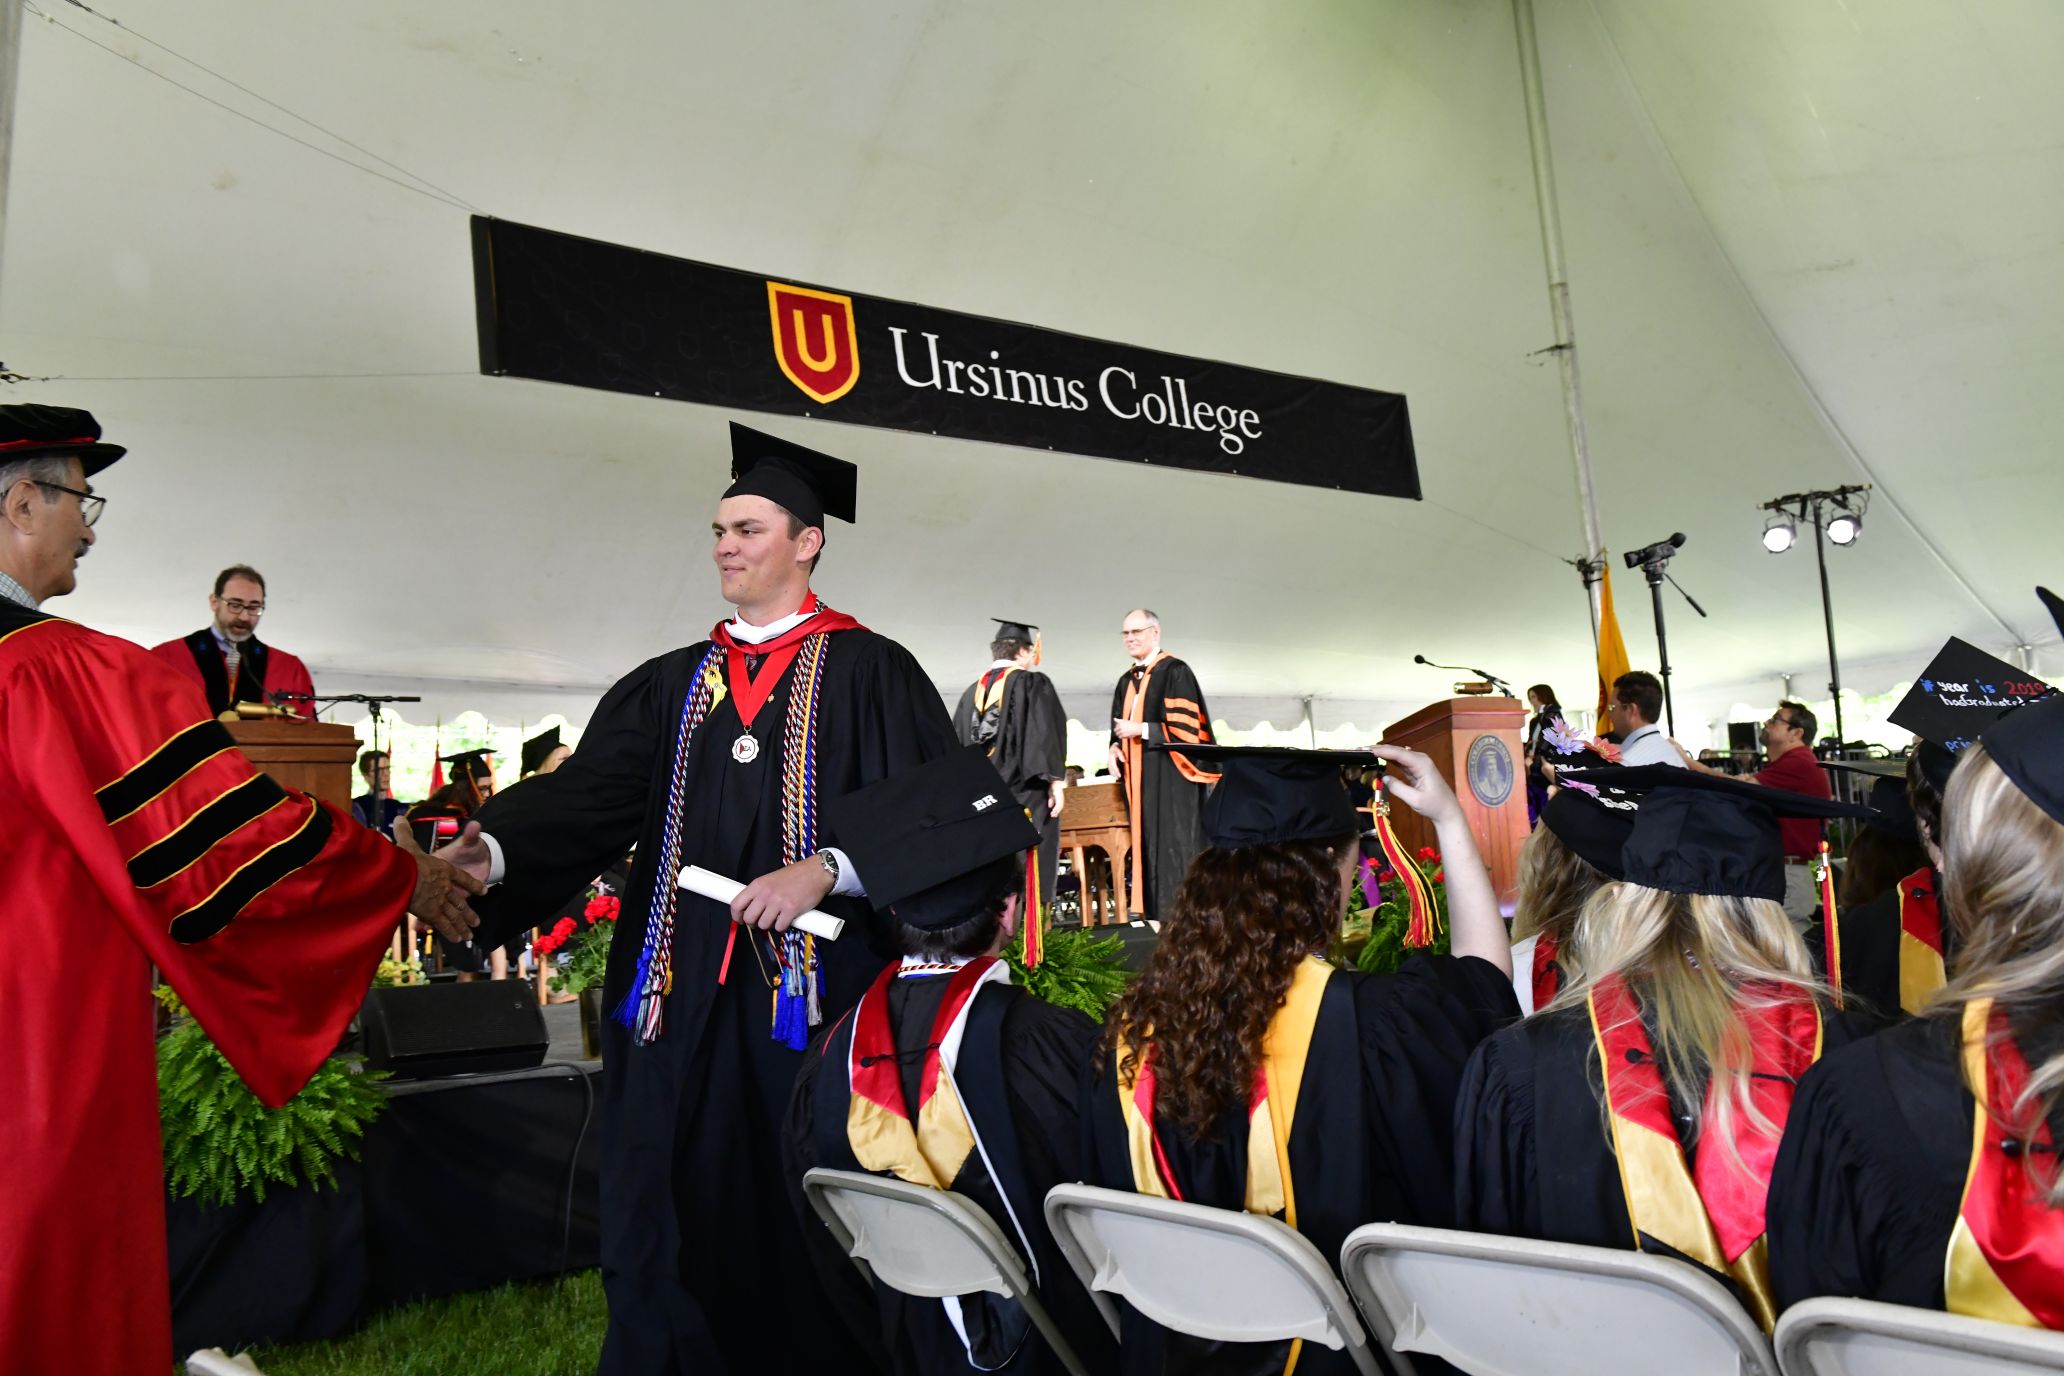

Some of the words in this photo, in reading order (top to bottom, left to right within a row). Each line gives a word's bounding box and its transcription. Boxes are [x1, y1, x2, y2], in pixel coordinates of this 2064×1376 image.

[793, 309, 837, 373] U
[888, 326, 1089, 411] Ursinus
[1099, 365, 1263, 455] College
[1937, 681, 1969, 692] year
[1975, 679, 1996, 694] is
[972, 794, 998, 811] BR
